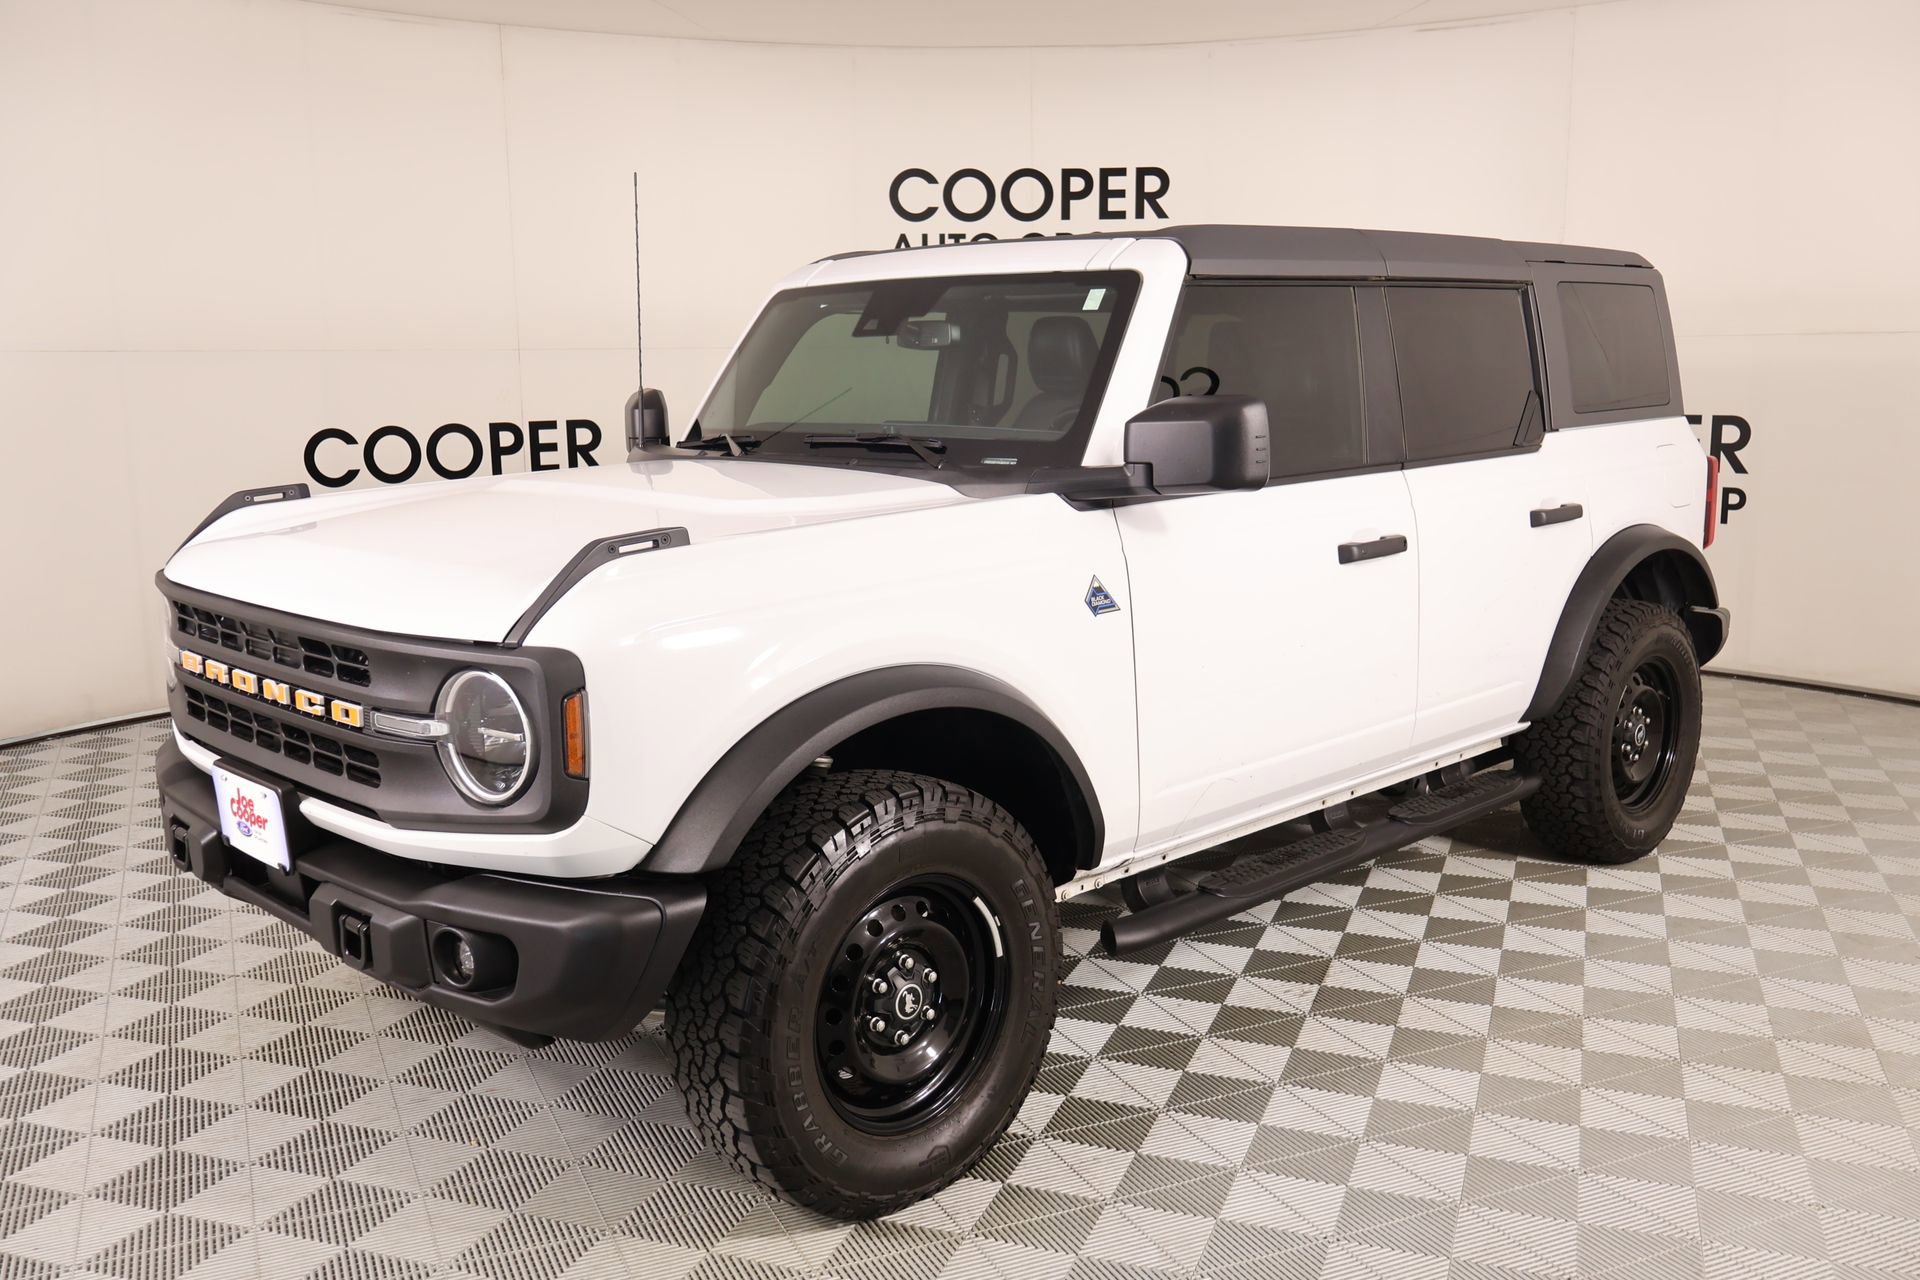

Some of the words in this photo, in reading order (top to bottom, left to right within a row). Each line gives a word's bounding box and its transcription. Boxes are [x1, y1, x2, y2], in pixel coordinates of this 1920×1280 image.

[889, 166, 1170, 222] COOPER
[303, 419, 602, 488] COOPER
[180, 650, 364, 728] BRONCO
[230, 797, 268, 831] Cooper
[236, 787, 254, 812] Joe
[1010, 879, 1047, 1043] GENERAL
[786, 1007, 848, 1167] GRABBER
